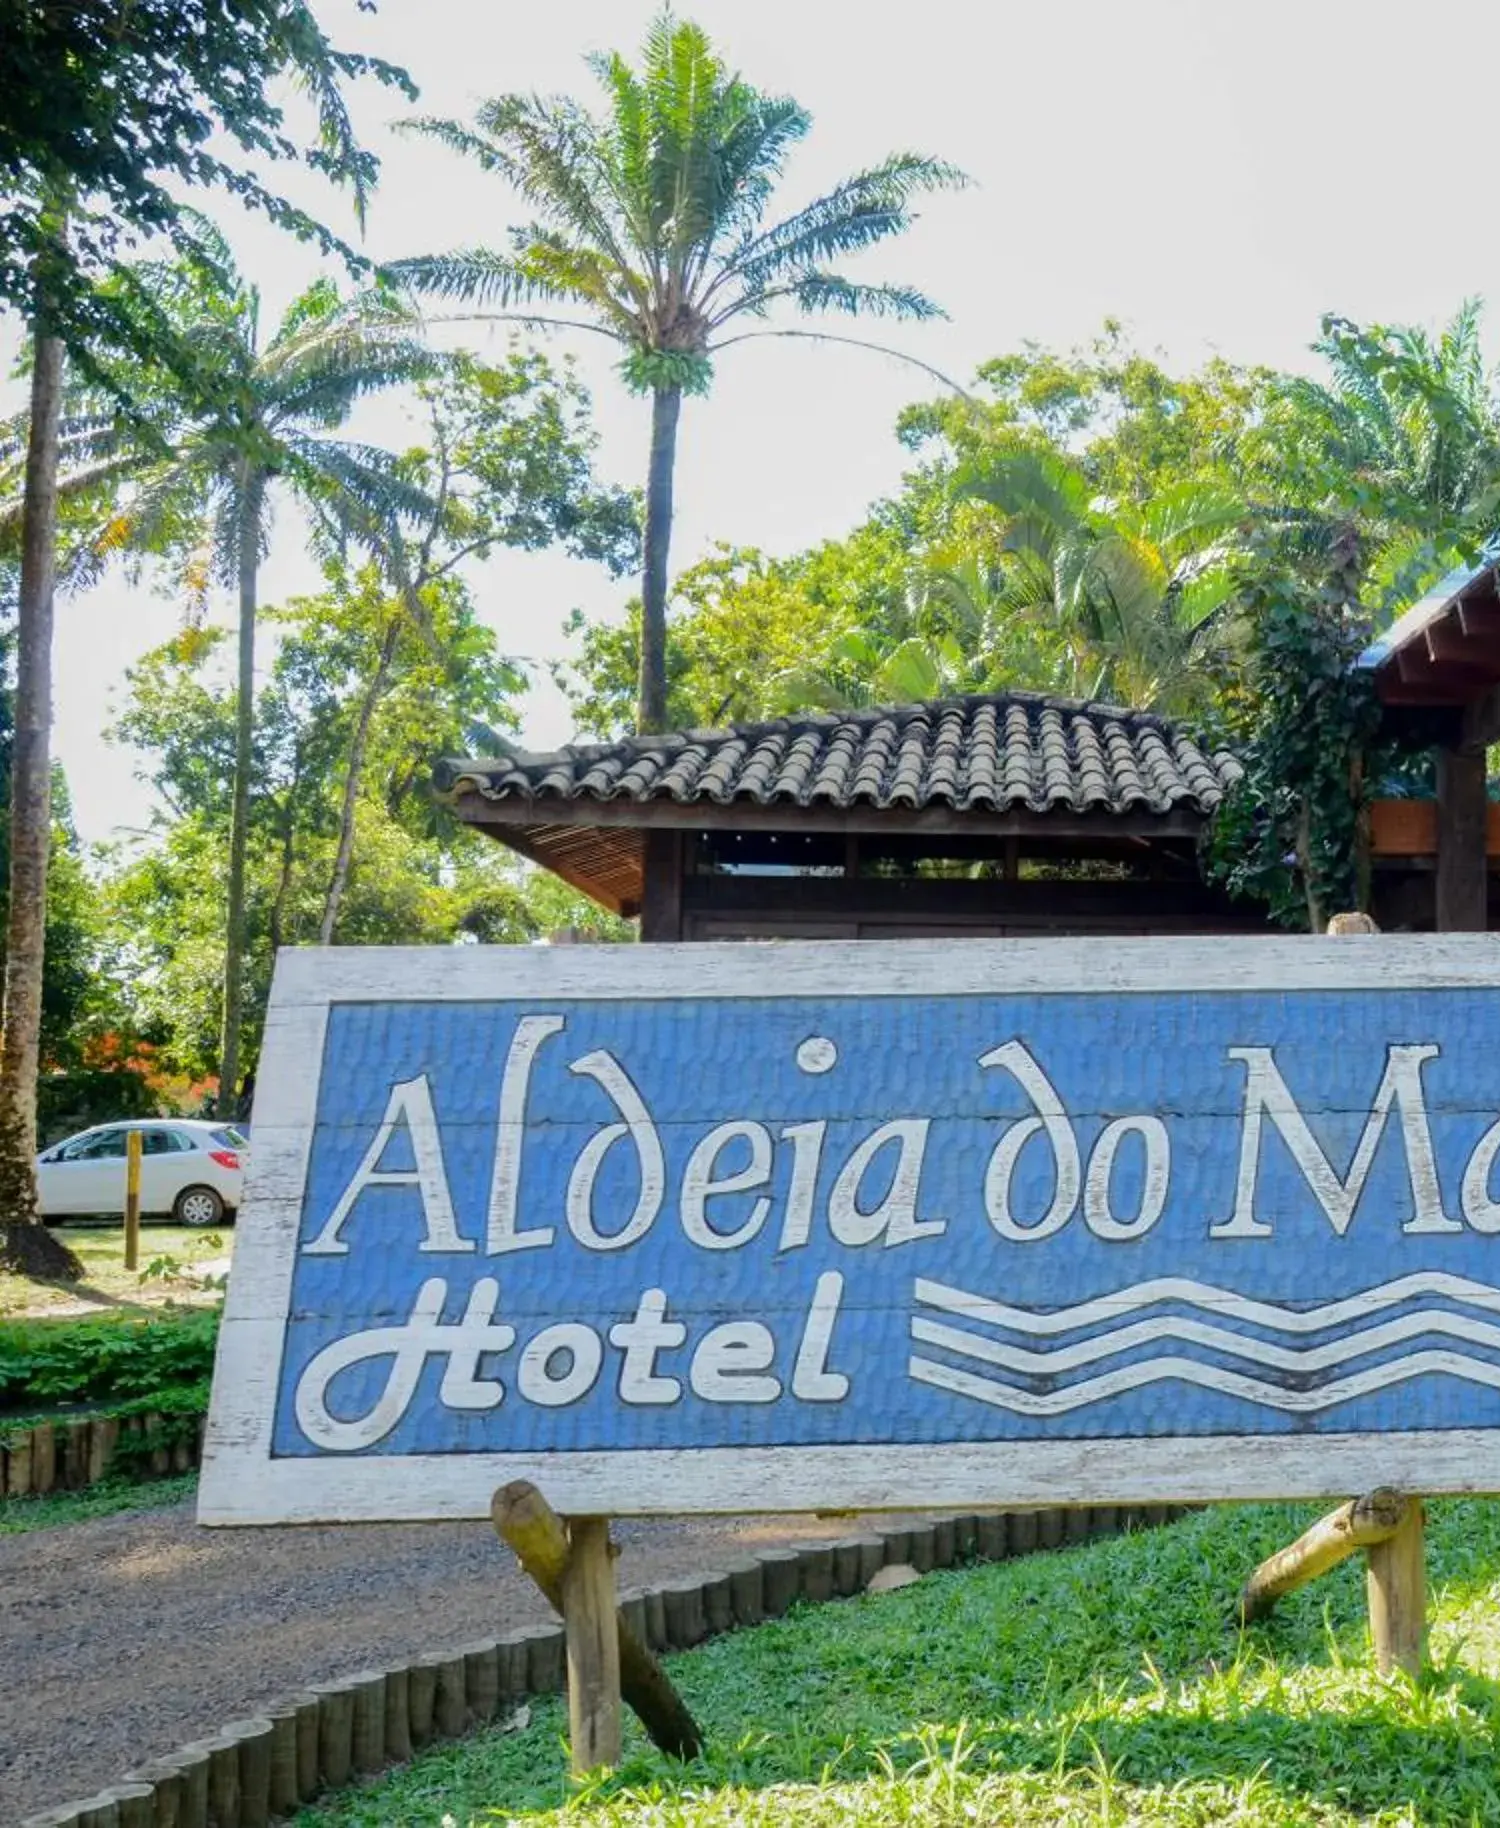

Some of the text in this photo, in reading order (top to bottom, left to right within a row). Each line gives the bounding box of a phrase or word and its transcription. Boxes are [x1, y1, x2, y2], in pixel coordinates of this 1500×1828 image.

[303, 1014, 947, 1257] Aldeia
[977, 1039, 1171, 1242] do
[296, 1270, 850, 1451] Hotel
